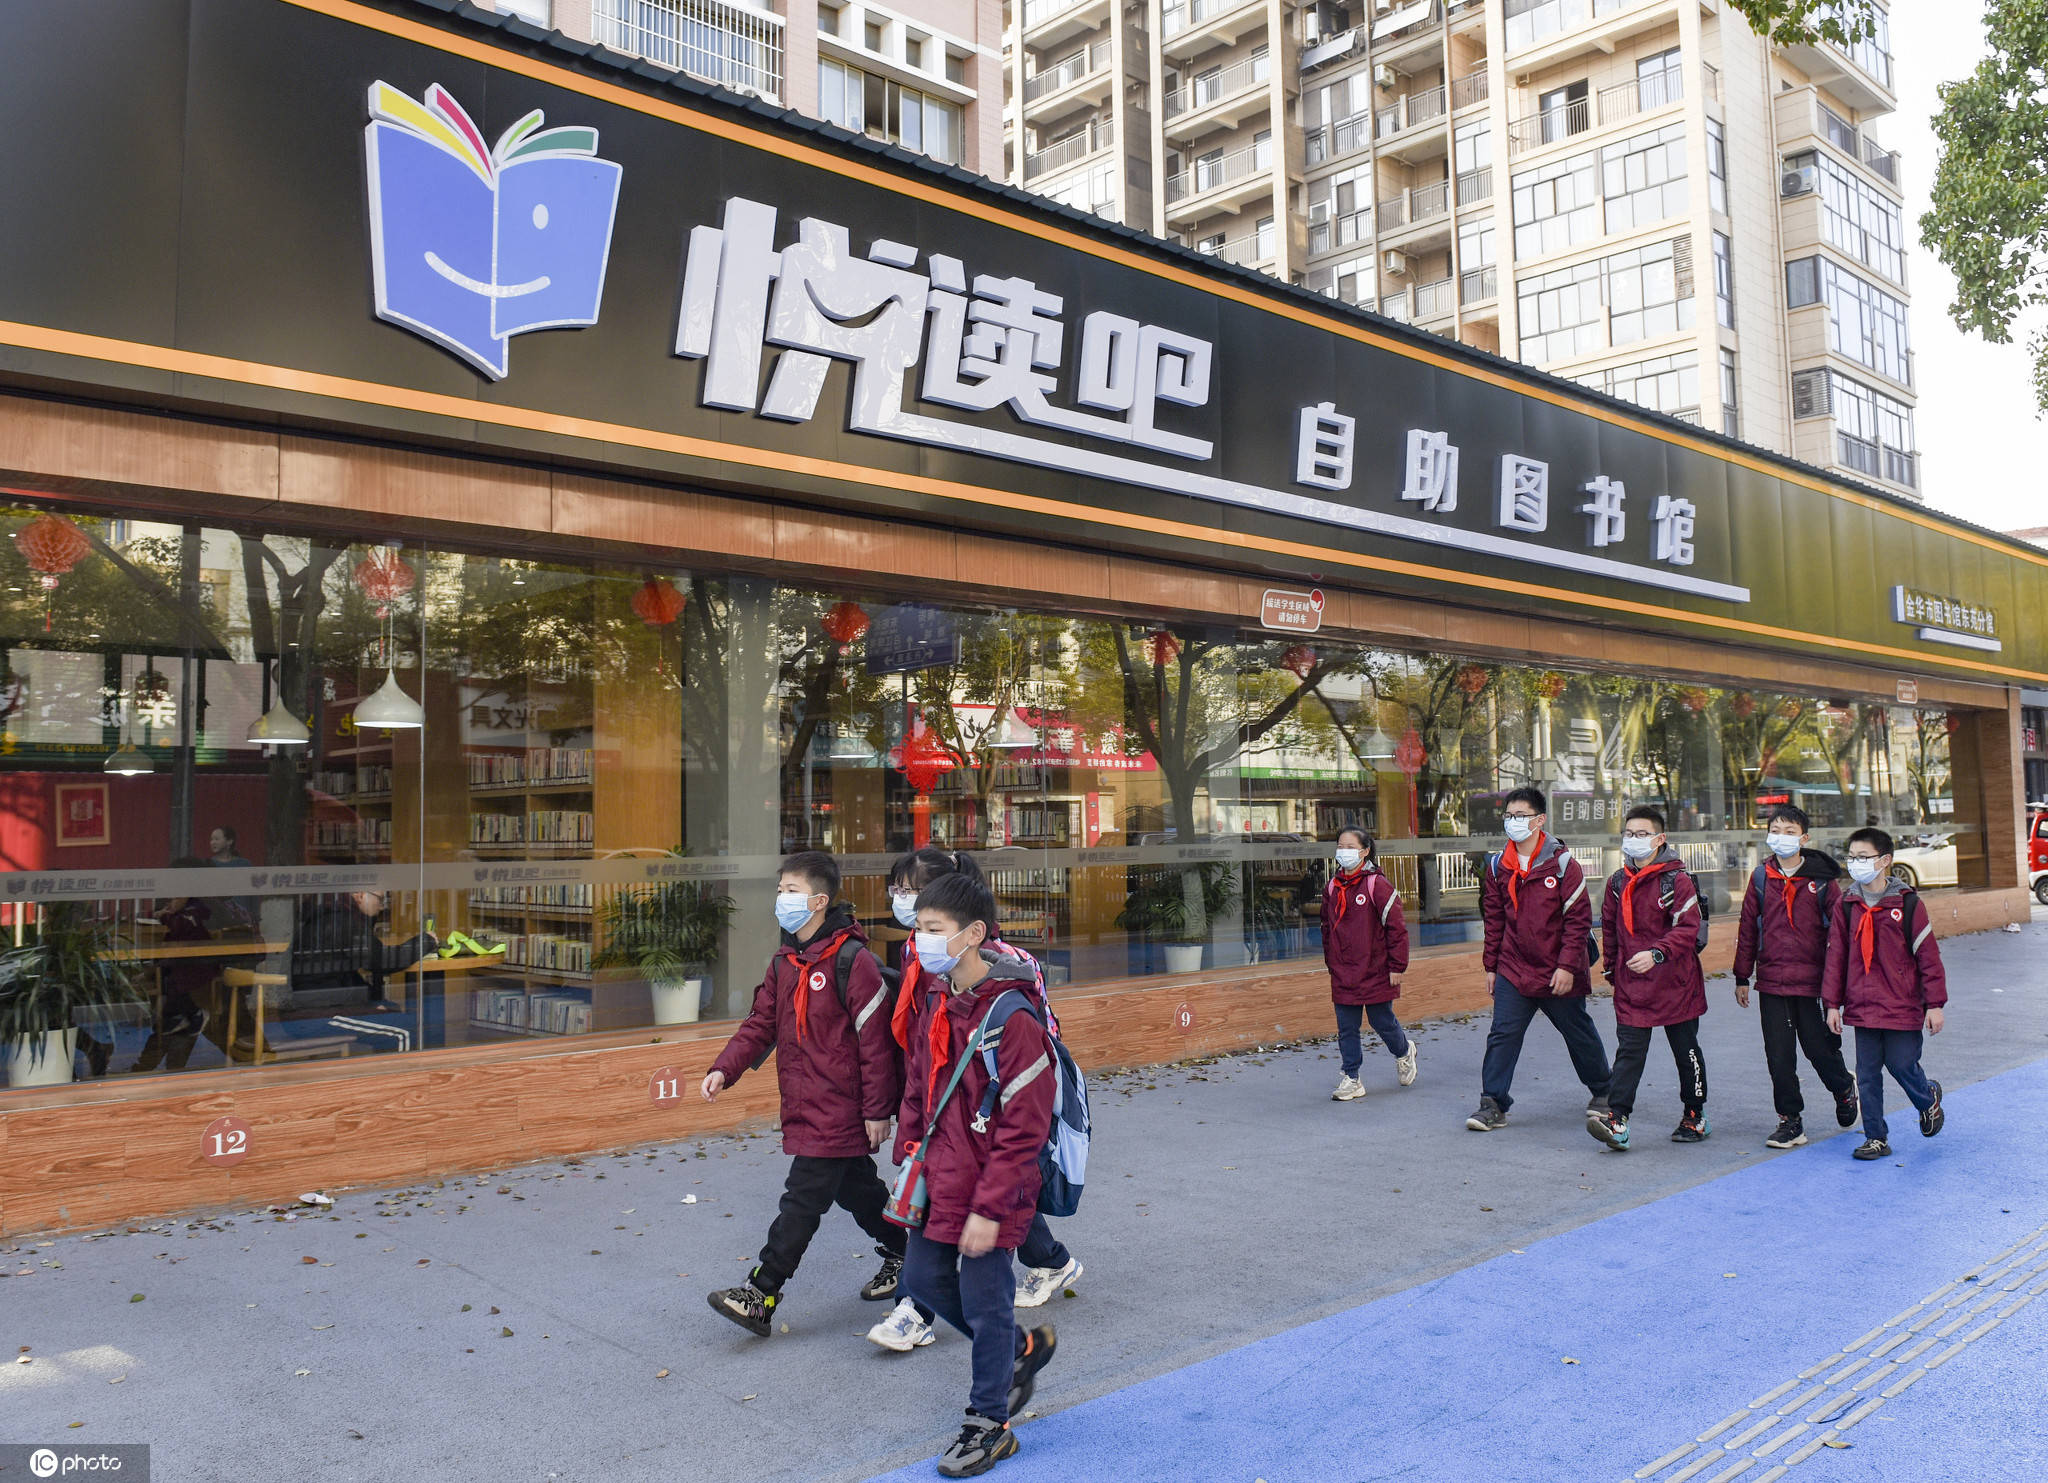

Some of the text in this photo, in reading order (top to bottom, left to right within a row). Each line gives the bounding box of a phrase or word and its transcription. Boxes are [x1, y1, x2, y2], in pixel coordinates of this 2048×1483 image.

[675, 196, 1697, 567] 悦读吧 自助图书馆
[1181, 1011, 1191, 1028] 9
[655, 1078, 680, 1100] 11
[209, 1130, 246, 1157] 12
